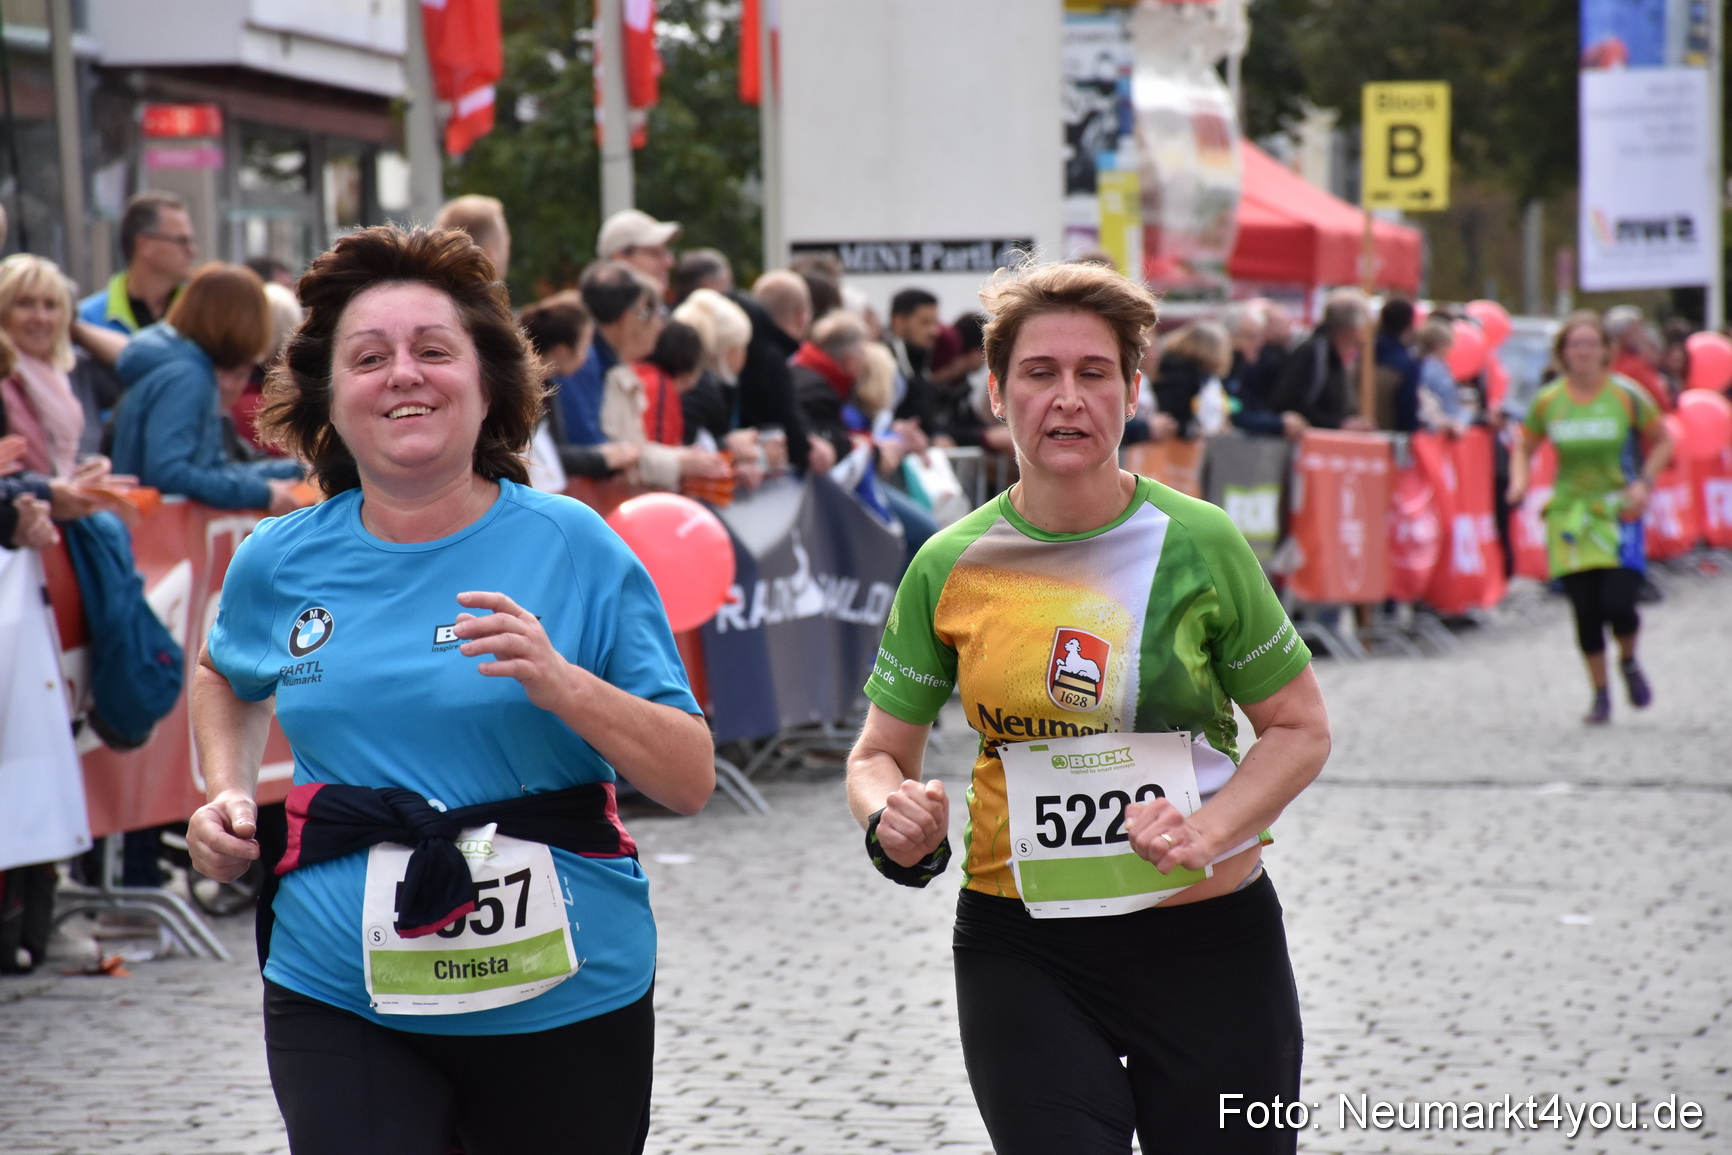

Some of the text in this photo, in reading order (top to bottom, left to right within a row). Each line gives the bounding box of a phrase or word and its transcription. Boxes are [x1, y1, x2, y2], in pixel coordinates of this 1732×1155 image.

[1387, 124, 1424, 178] B
[295, 609, 331, 629] BMW
[431, 640, 462, 653] inspire
[280, 660, 323, 677] PARTL
[281, 673, 322, 687] Neumarkt
[1059, 690, 1088, 709] 1628
[976, 701, 1119, 738] Neuma
[1068, 746, 1134, 769] BOCK
[1113, 762, 1136, 770] concepts
[1020, 843, 1028, 853] S
[392, 867, 532, 940] 57
[373, 931, 381, 942] S
[433, 956, 509, 980] Christa
